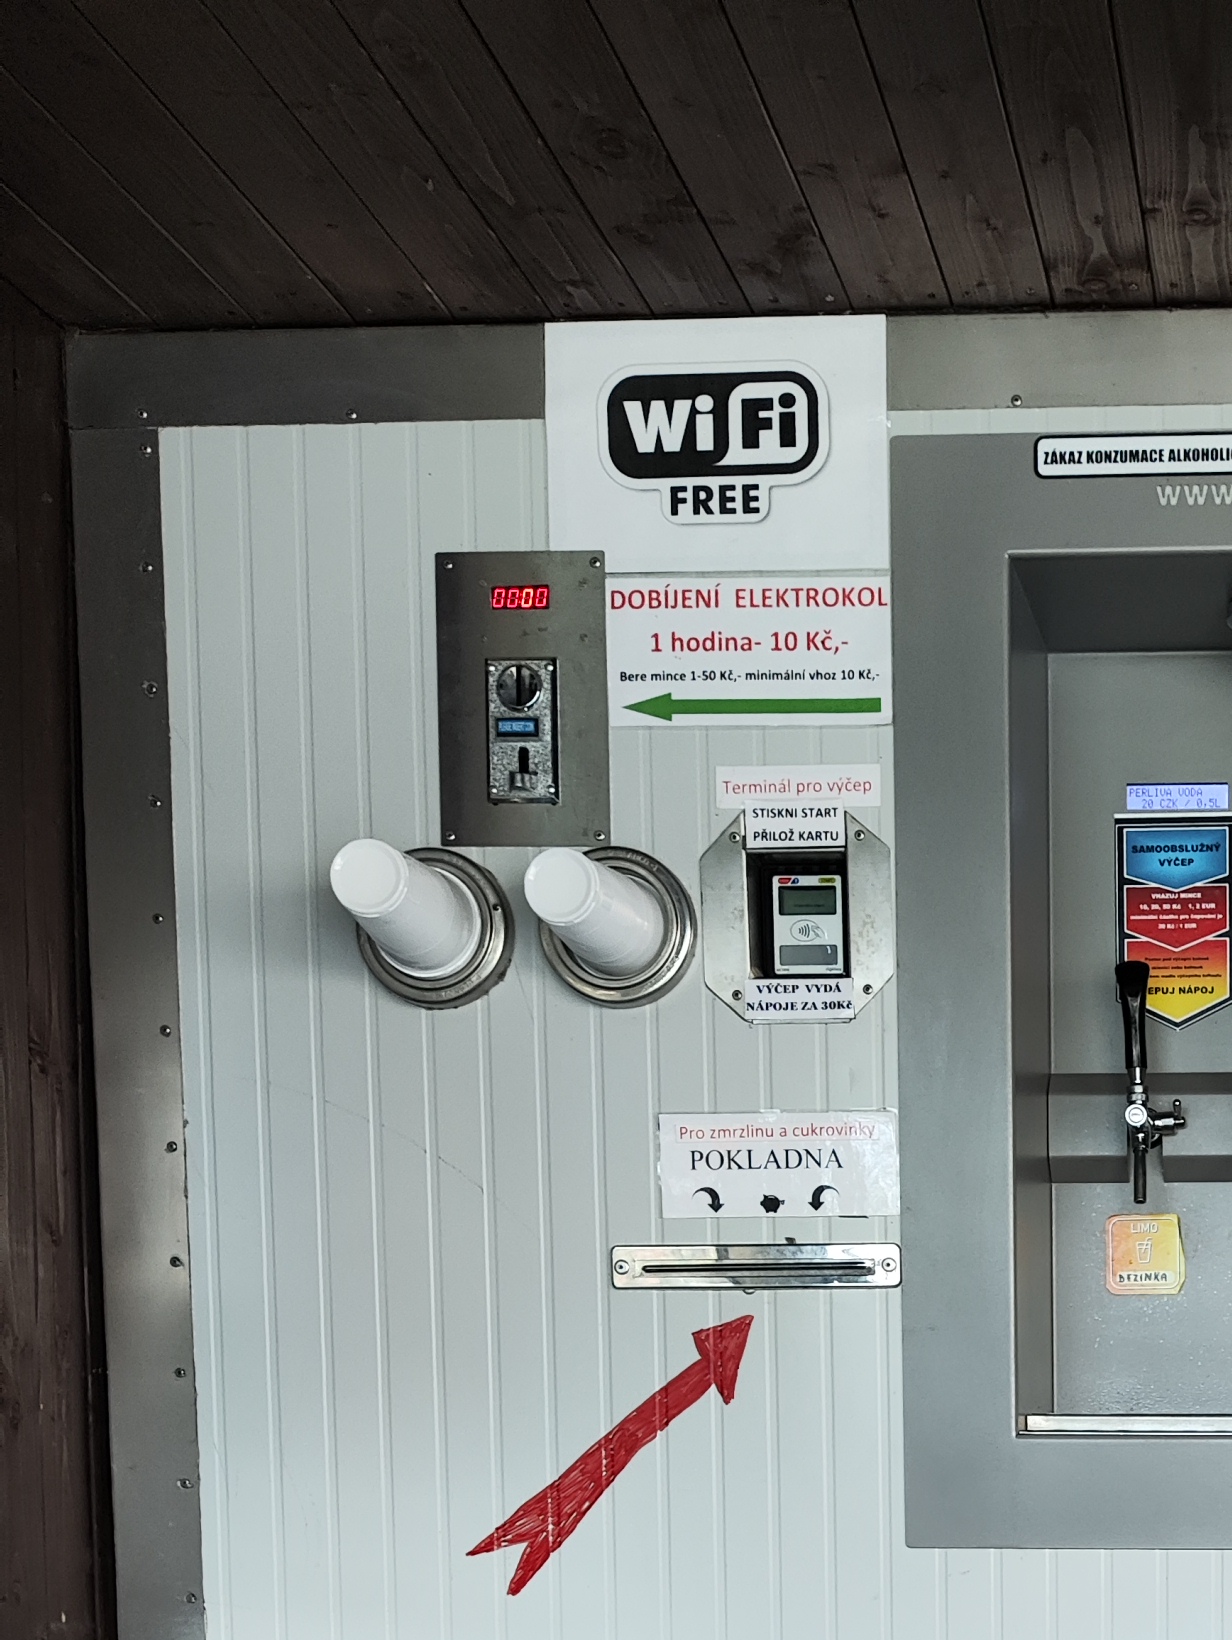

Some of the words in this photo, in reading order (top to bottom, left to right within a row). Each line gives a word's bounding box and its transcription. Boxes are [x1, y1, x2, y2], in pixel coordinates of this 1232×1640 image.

[1043, 449, 1083, 465] ZÁKAZ
[1086, 449, 1165, 464] KONZUMACE
[670, 483, 761, 516] FREE
[610, 582, 721, 610] DOBÍJENÍ
[735, 587, 888, 609] ELEKTROKOL
[650, 633, 662, 652] 1
[671, 631, 762, 652] hodina-
[770, 631, 798, 652] 10
[806, 629, 849, 655] Kč,-
[620, 671, 647, 682] Bere
[650, 671, 687, 682] mince
[690, 671, 716, 682] 1-50
[720, 669, 742, 683] Kč,-
[745, 669, 806, 681] minimální
[808, 669, 837, 681] vhoz
[840, 670, 855, 681] 10
[858, 669, 880, 682] Kč,-
[723, 778, 791, 795] Terminál
[796, 782, 822, 798] pro
[827, 777, 873, 796] výčep
[1129, 788, 1172, 797] PERLIVA
[1178, 787, 1203, 797] VODA
[1142, 800, 1154, 809] 20
[1160, 799, 1178, 809] CZK
[1196, 799, 1221, 809] 0,5L
[752, 807, 799, 819] STISKNI
[801, 807, 839, 818] START
[753, 827, 795, 842] PŘILOŽ
[798, 830, 839, 841] KARTU
[1131, 842, 1221, 854] SAMOOBSLUŽNÝ
[1158, 857, 1194, 867] VÝČEP
[756, 982, 800, 995] VÝČEP
[805, 982, 842, 994] VYDÁ
[1148, 986, 1175, 995] EPUJ
[1179, 985, 1215, 995] NÁPOJ
[746, 999, 799, 1012] NÁPOJE
[801, 1001, 819, 1011] ZA
[821, 1000, 853, 1011] 30Kč
[679, 1126, 705, 1140] Pro
[710, 1124, 774, 1140] zmrzlinu
[780, 1127, 788, 1138] a
[792, 1122, 876, 1139] cukrovinky
[690, 1148, 843, 1170] POKLADNA
[1130, 1222, 1158, 1234] LIMO
